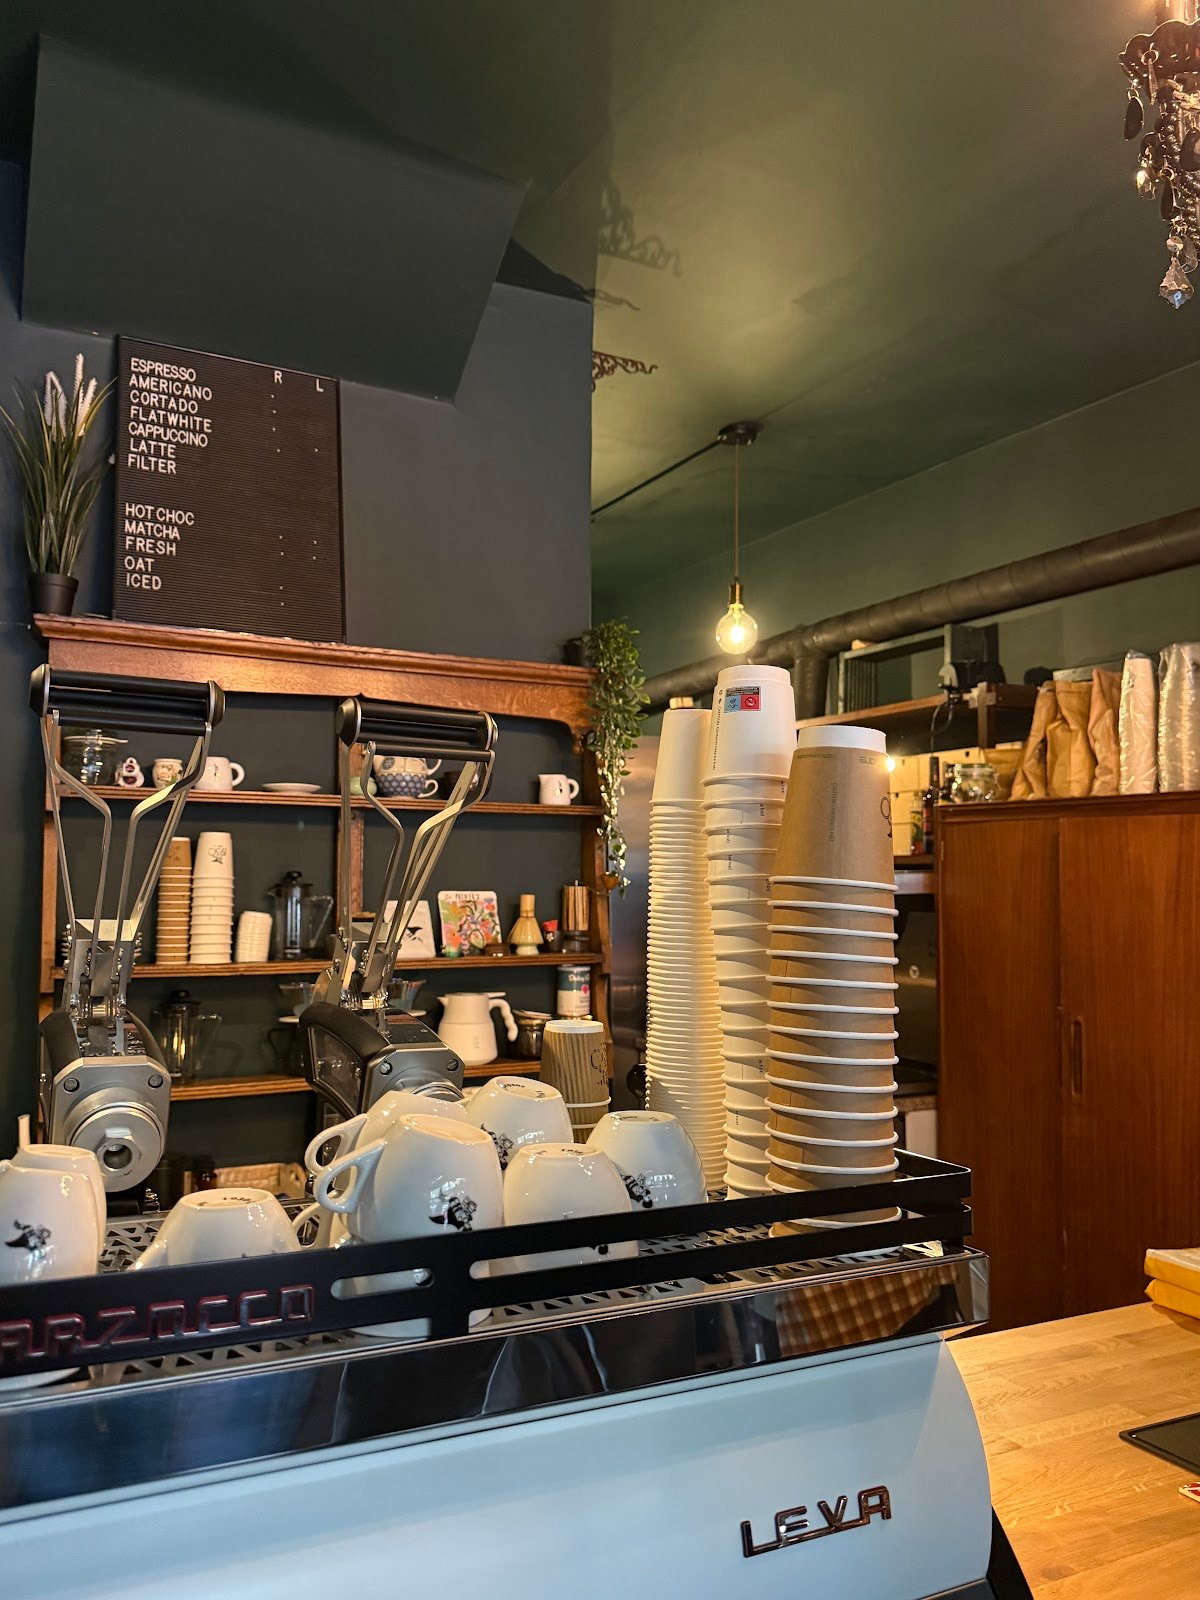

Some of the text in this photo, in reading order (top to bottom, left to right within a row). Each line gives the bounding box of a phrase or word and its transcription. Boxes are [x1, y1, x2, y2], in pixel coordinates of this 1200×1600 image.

[130, 357, 197, 382] ESPRESSO
[128, 373, 213, 401] AMERICANO
[273, 370, 325, 393] R L
[129, 389, 199, 414] CORTADO
[130, 405, 213, 433] FLATWHITE
[128, 421, 209, 448] CAPPUCCINO
[129, 437, 177, 459] LATTE
[127, 453, 177, 475] FILTER
[125, 502, 195, 526] HOT CHOC
[124, 519, 181, 541] MATCHA
[125, 535, 177, 556] FRESH
[124, 555, 155, 573] OAT
[126, 572, 162, 591] ICED
[741, 1485, 892, 1558] LEVA
